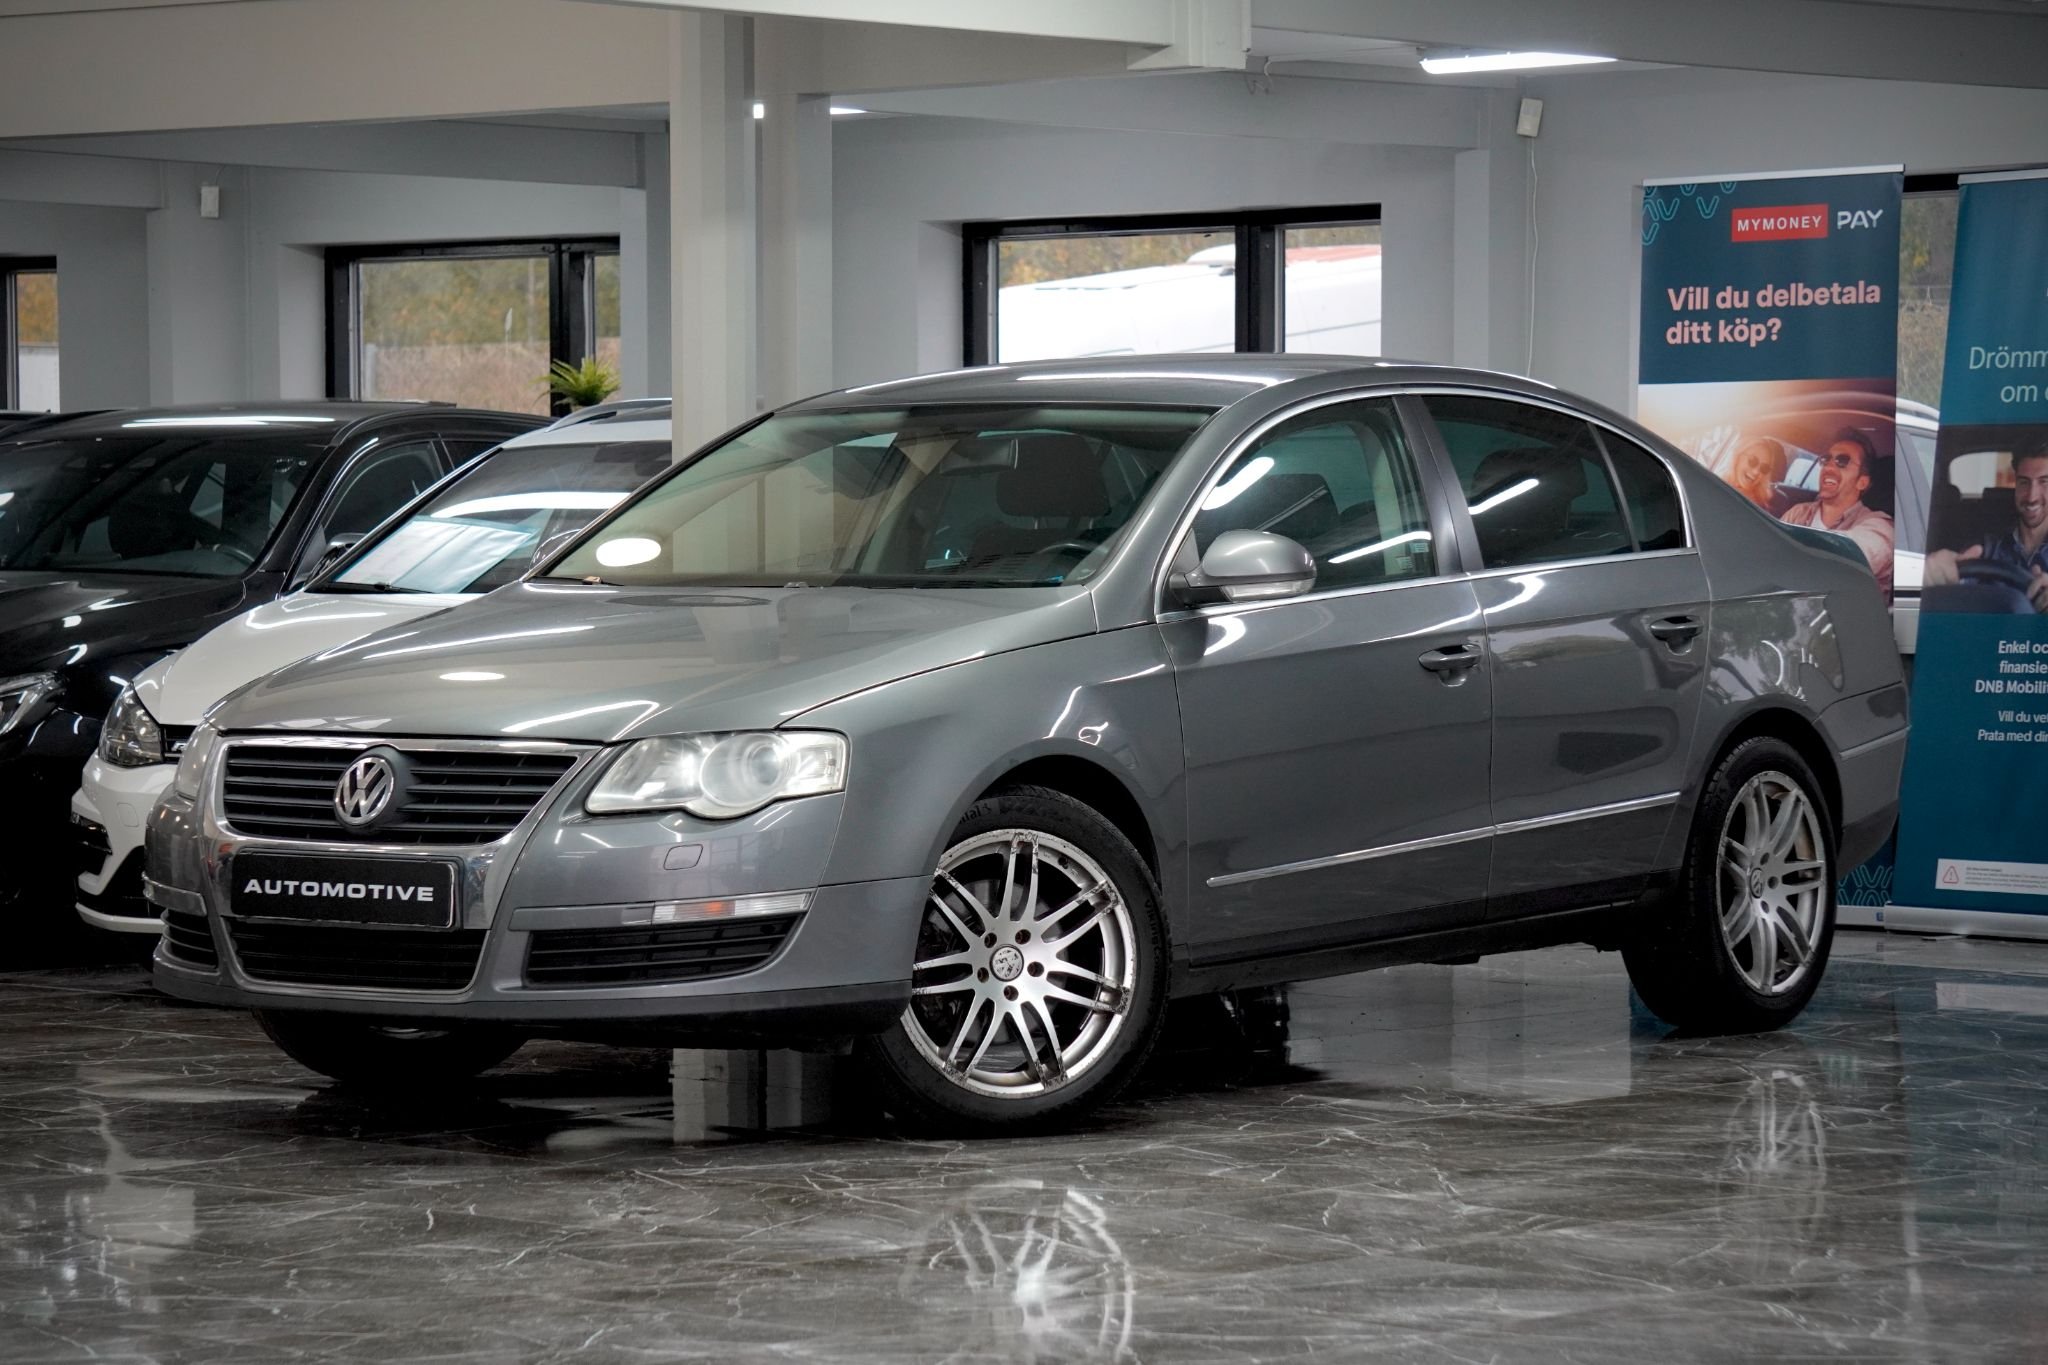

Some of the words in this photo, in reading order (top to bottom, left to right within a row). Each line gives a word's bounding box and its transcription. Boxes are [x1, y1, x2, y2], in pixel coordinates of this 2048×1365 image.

[1737, 215, 1822, 232] MYMONEY
[1836, 209, 1884, 230] PAY
[1667, 286, 1709, 311] Vill
[1715, 285, 1749, 309] du
[1756, 280, 1882, 308] delbetala
[1666, 320, 1712, 344] ditt
[1718, 317, 1782, 347] köp?
[2000, 385, 2038, 403] om
[1998, 640, 2030, 654] Enkel
[1975, 679, 2004, 693] DNB
[2006, 680, 2048, 694] Mobili
[1998, 710, 2014, 722] Vill
[2015, 711, 2031, 723] du
[1977, 728, 2005, 741] Prata
[2006, 730, 2033, 742] med
[243, 879, 435, 902] AUTOMOTIVE
